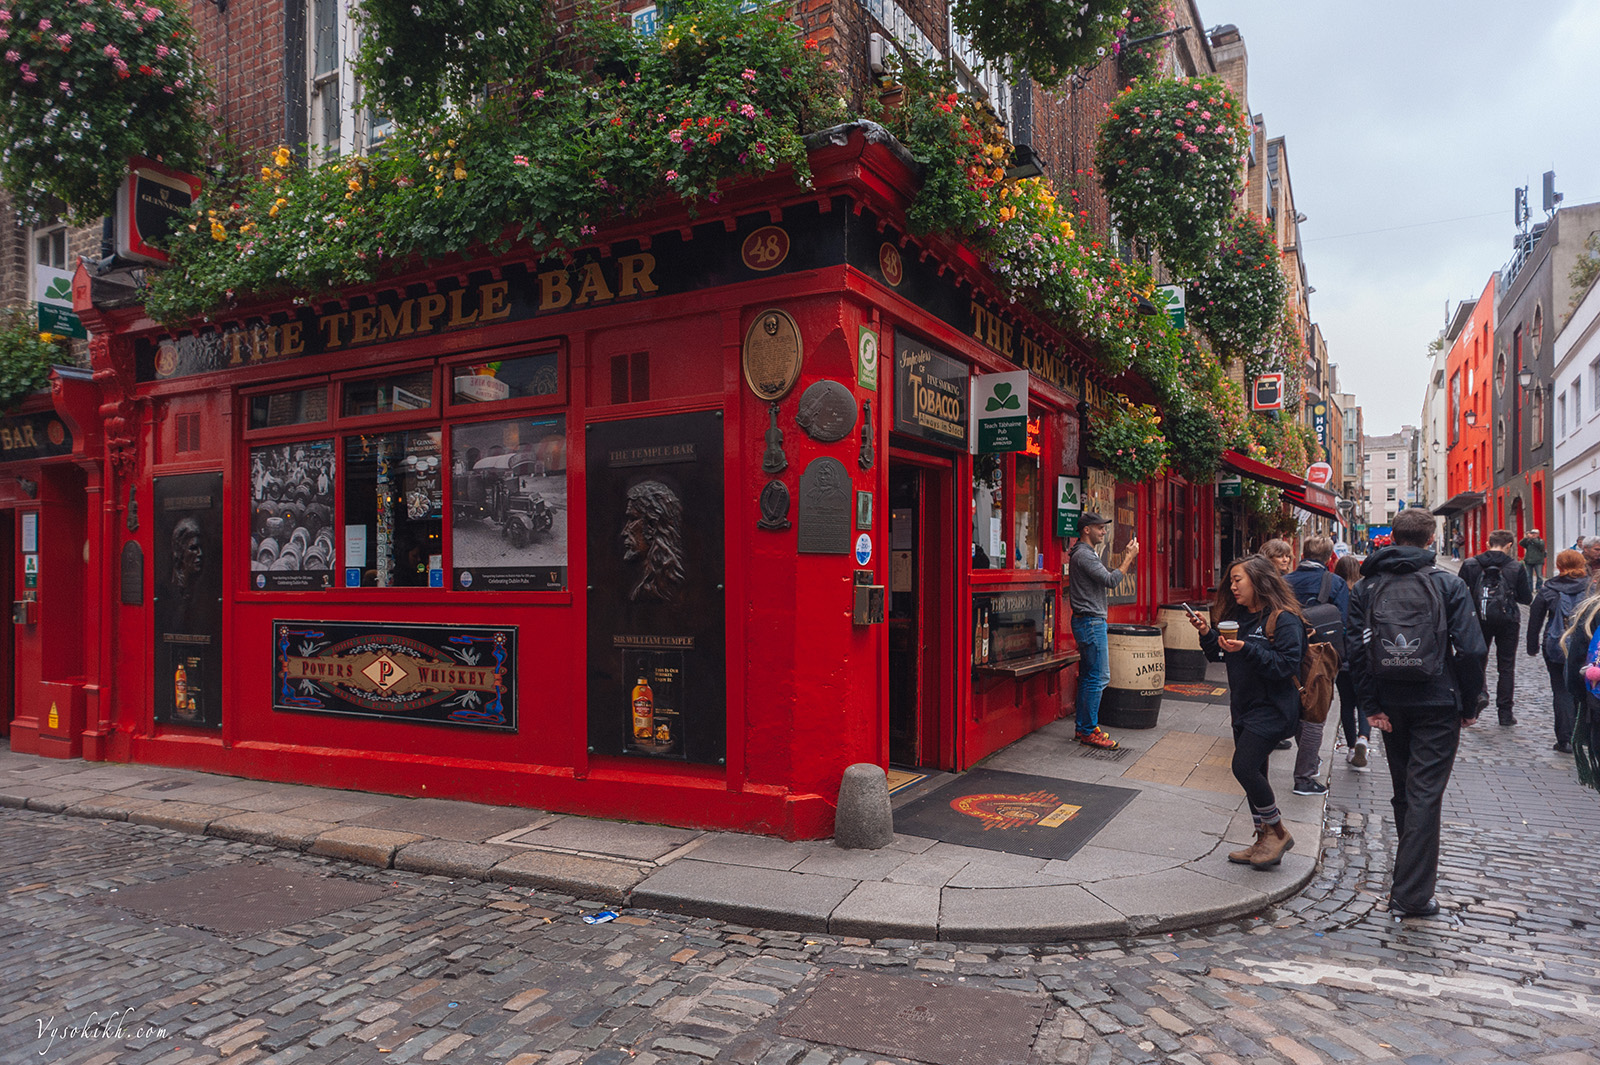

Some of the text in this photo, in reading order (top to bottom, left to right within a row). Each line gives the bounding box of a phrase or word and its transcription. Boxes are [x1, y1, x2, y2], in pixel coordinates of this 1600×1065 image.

[750, 234, 780, 263] 48
[884, 250, 898, 276] 48
[226, 252, 659, 364] THE TEMPLE BAR
[971, 301, 1014, 360] THE
[1020, 334, 1080, 400] TEMPLE
[907, 372, 960, 422] TOBACCO
[927, 373, 960, 396] FINE SMOKING
[0, 424, 38, 450] BAR
[919, 413, 940, 428] Always
[947, 422, 963, 437] Stock
[1316, 417, 1324, 444] HOS
[610, 443, 694, 461] THE TEMPLE BAR
[331, 636, 440, 658] JOHN'S LANE DISTILLERY
[613, 635, 693, 646] SIR WILLIAM TEMPLE
[302, 660, 487, 686] POWERS P WHISKEY
[1381, 656, 1423, 667] adidas
[333, 688, 436, 711] PURE POT STILL
